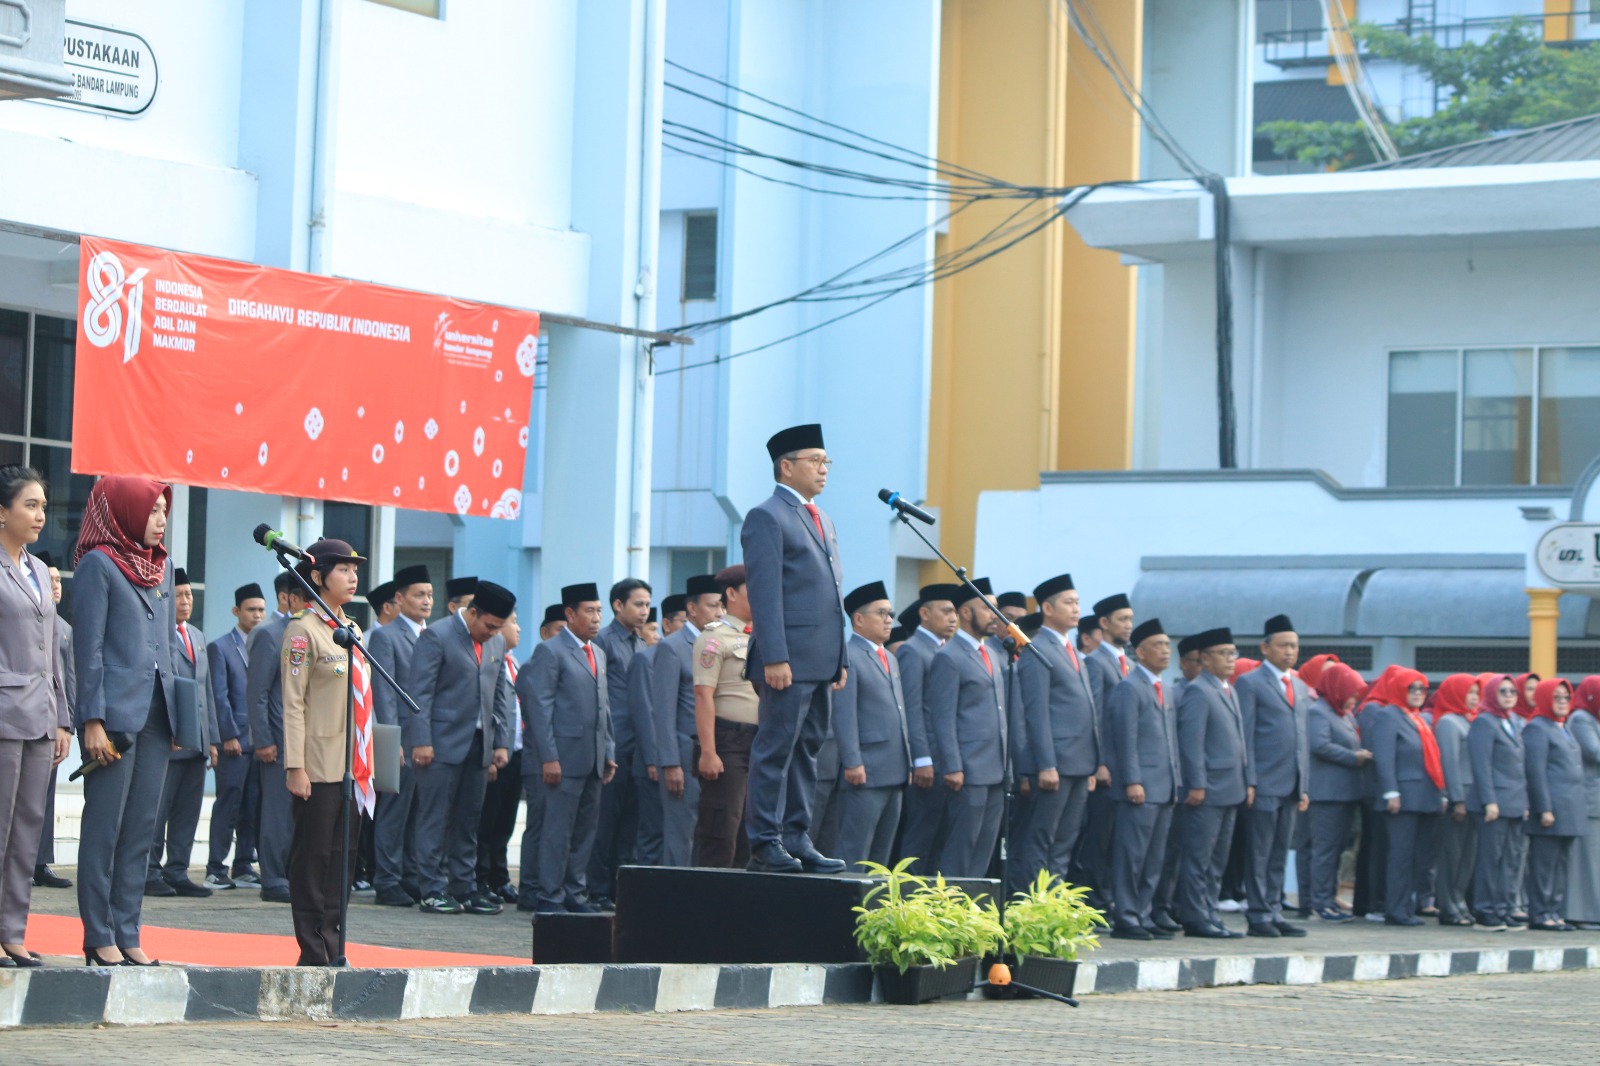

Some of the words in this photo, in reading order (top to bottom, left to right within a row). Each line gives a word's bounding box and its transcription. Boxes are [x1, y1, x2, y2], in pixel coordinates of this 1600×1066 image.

[77, 74, 105, 93] BANDAR
[106, 80, 139, 99] LAMPUNG
[155, 279, 203, 299] INDONESIA
[155, 297, 208, 318] BERDAULAT
[153, 315, 175, 331] ADIL
[177, 318, 196, 334] DAN
[228, 298, 294, 325] DIRGAHAYU
[297, 309, 351, 333] REPUBLIK
[352, 318, 411, 343] INDONESIA
[153, 333, 196, 352] MAKMUR
[444, 330, 494, 348] universitas
